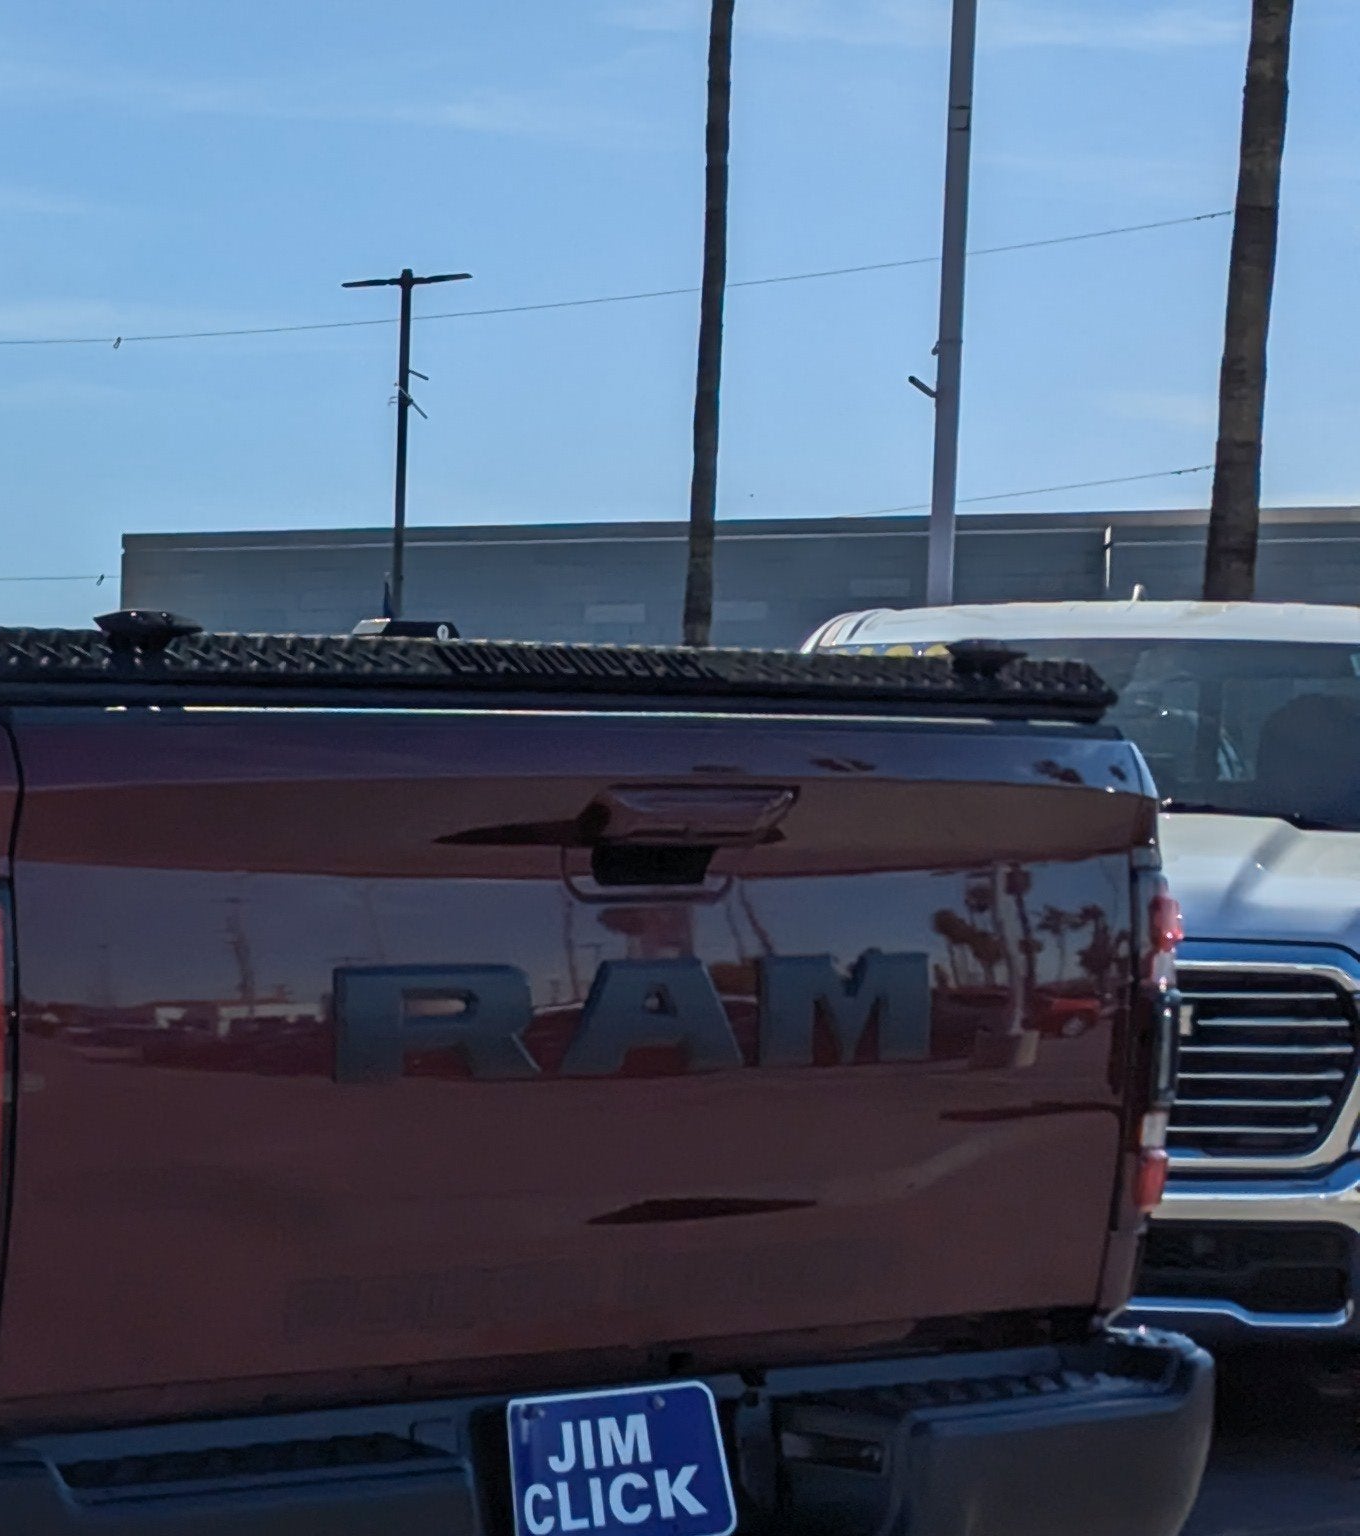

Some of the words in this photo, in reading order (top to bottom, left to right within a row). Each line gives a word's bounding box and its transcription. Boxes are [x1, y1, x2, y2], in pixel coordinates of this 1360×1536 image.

[333, 948, 930, 1082] RAM
[548, 1414, 653, 1473] JIM
[524, 1465, 707, 1535] CLICK
